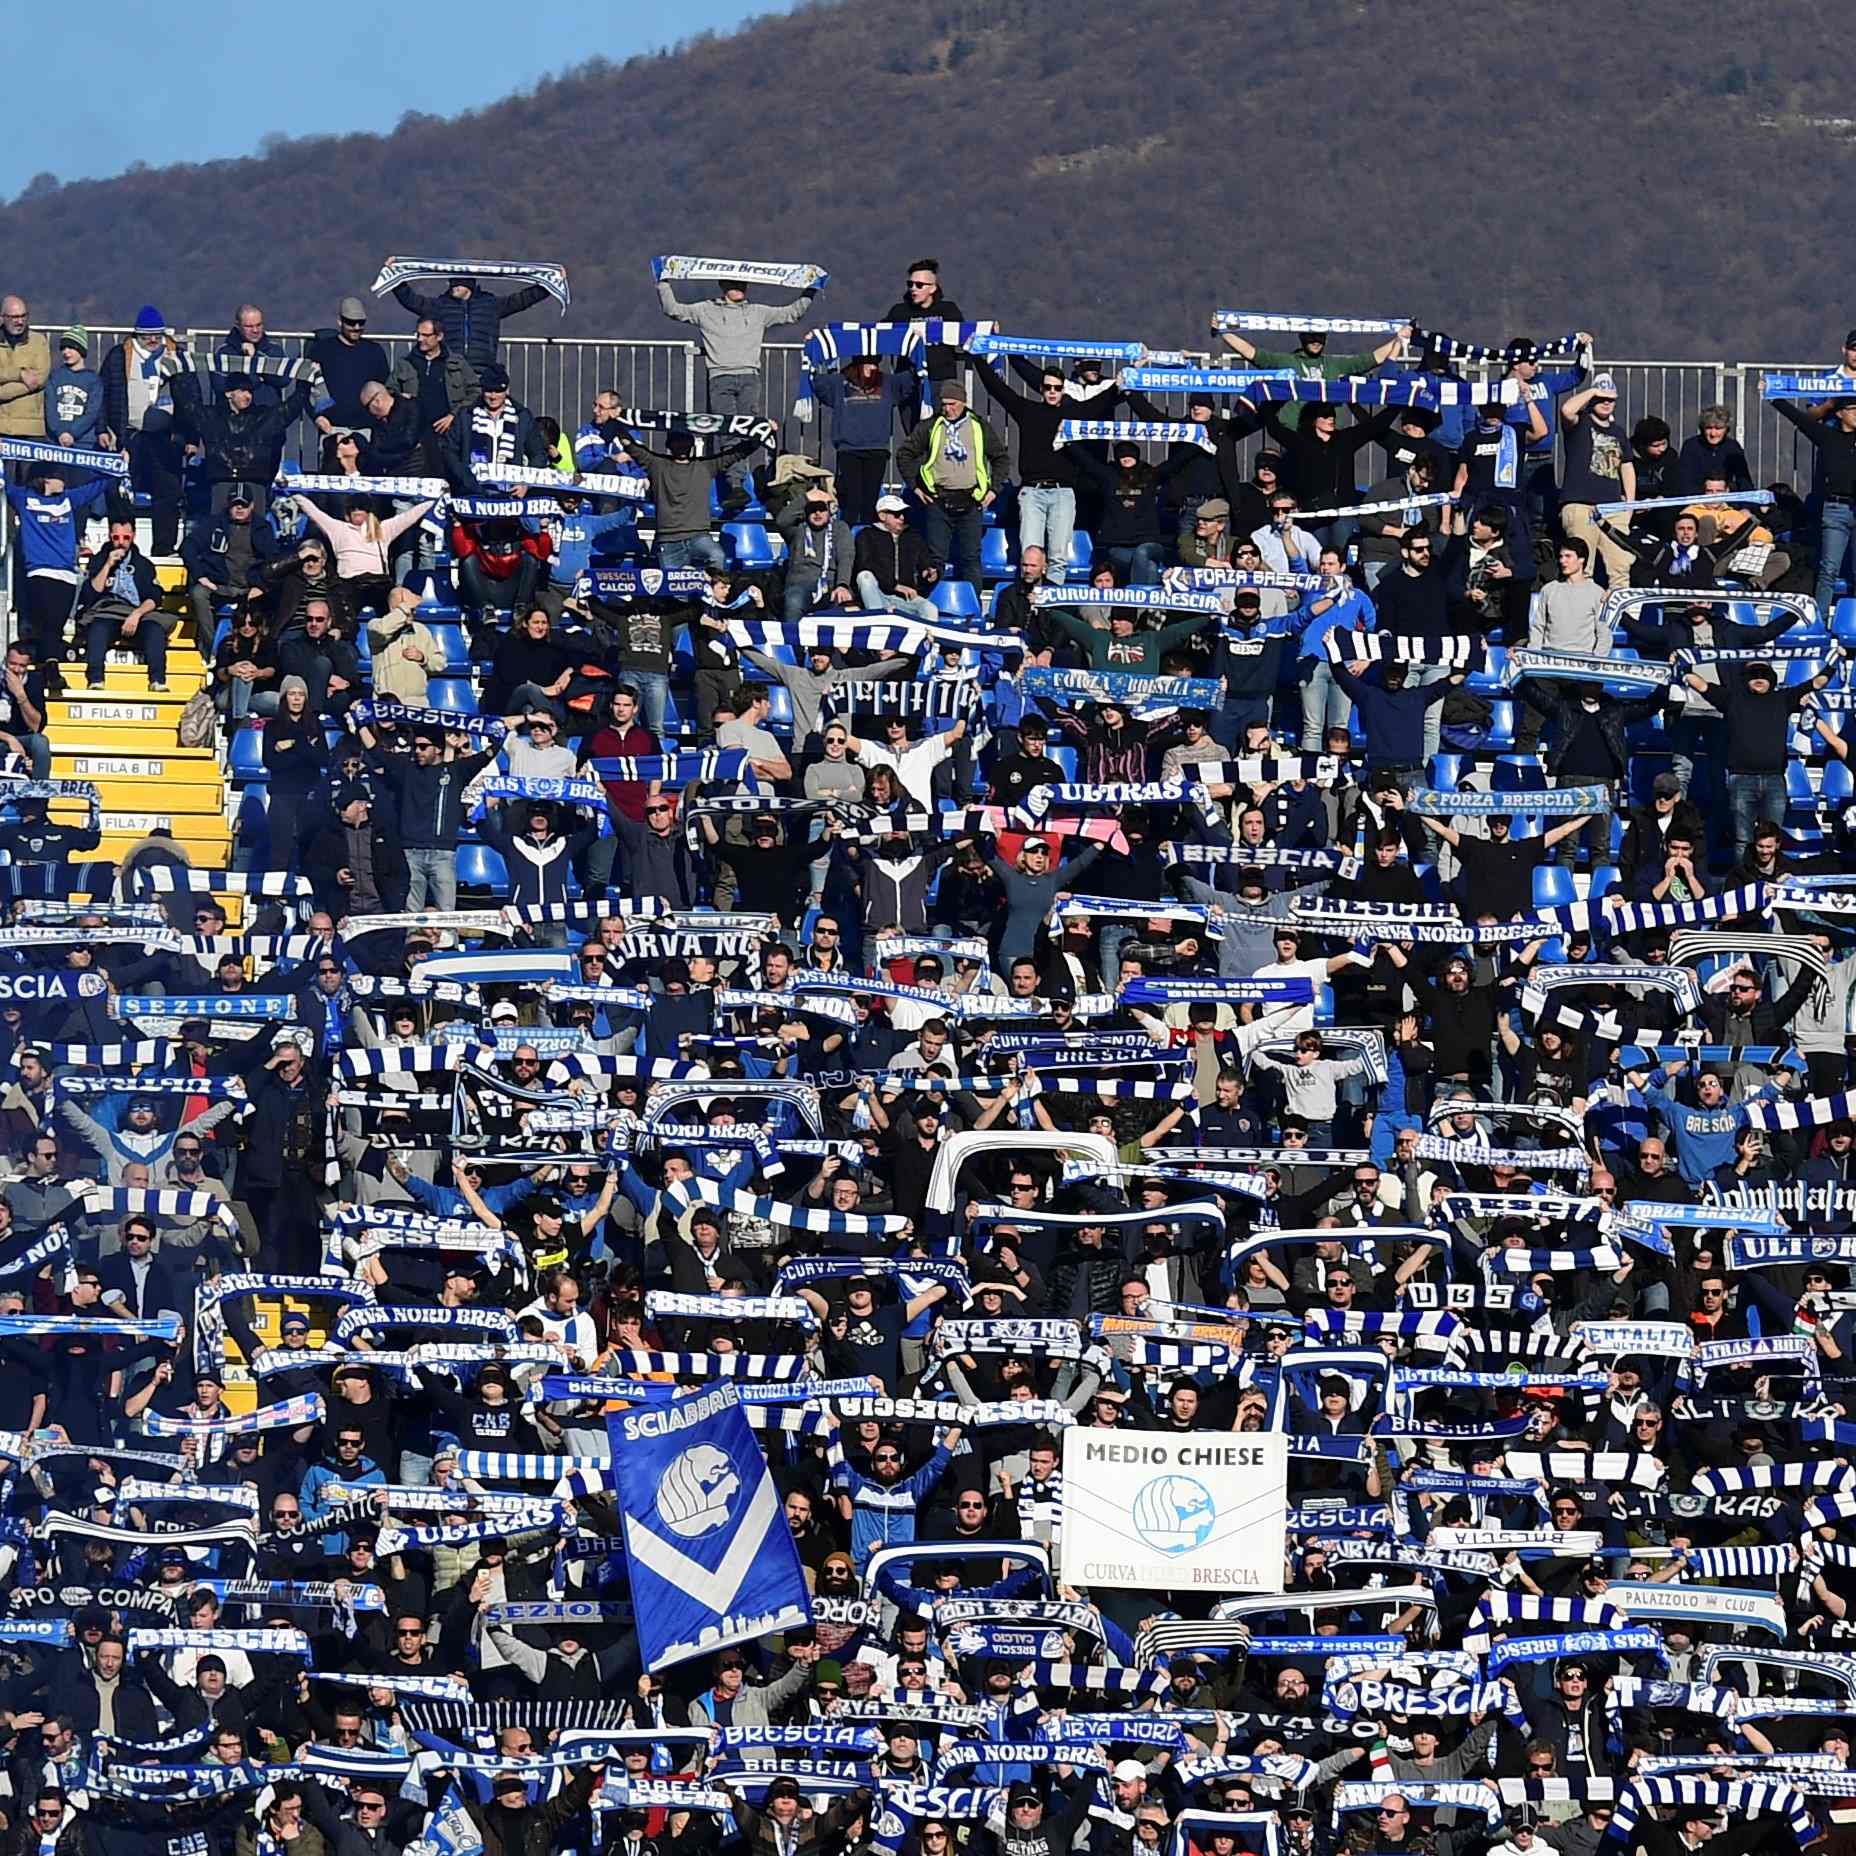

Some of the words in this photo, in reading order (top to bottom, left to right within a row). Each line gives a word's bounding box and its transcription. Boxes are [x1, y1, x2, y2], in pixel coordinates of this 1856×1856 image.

[698, 259, 733, 271] Forza
[739, 263, 786, 278] Brescia
[1142, 373, 1202, 387] BRESCIA
[1207, 374, 1275, 387] FOREVER
[1798, 377, 1845, 391] ULTRAS
[91, 707, 121, 718] FILA
[97, 762, 127, 774] FILA
[104, 817, 130, 829] FILA
[126, 996, 281, 1016] SEZIONE
[1087, 1443, 1168, 1464] MEDIO
[1178, 1447, 1265, 1466] CHIESE
[1083, 1562, 1137, 1582] CURVA
[1192, 1568, 1260, 1585] BRESCIA
[1625, 1591, 1699, 1608] PALAZZOLO
[1724, 1598, 1755, 1612] CLUB
